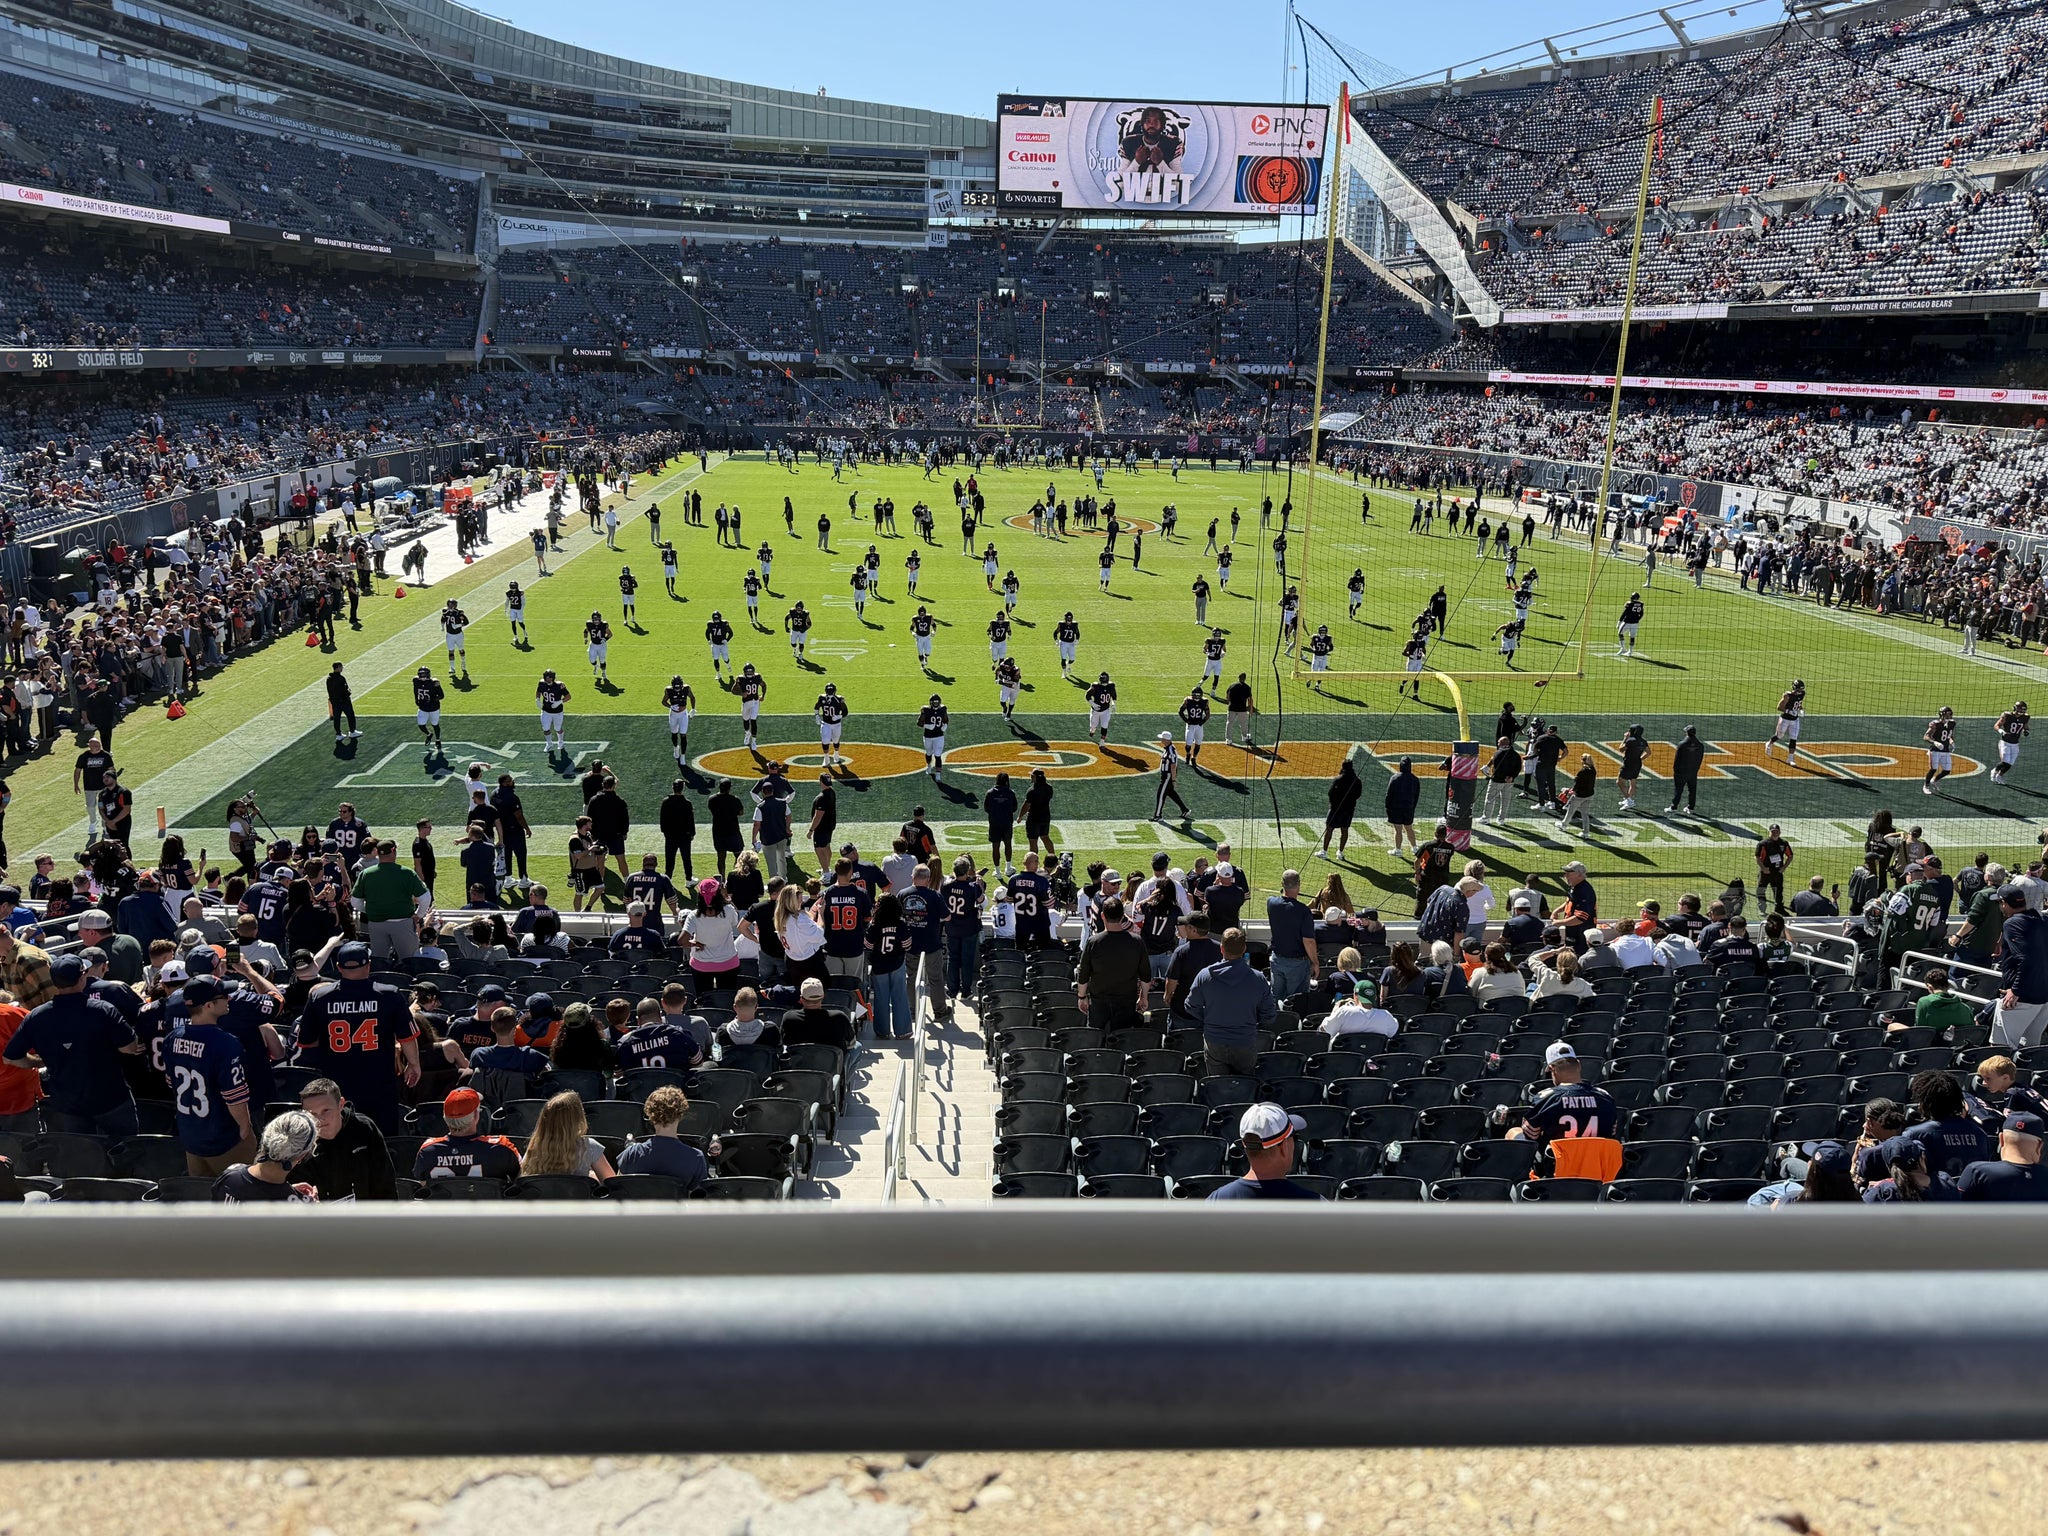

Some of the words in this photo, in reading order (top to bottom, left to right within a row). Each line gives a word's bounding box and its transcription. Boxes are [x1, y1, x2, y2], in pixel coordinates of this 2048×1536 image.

[1273, 118, 1313, 134] PNC
[1016, 133, 1049, 142] WARMUPS
[1008, 150, 1056, 163] Canon
[1104, 171, 1195, 205] SWIFT
[963, 193, 995, 205] 35:21
[1014, 194, 1056, 203] NOVARTIS
[18, 188, 44, 201] Canon
[62, 197, 83, 208] PROUD
[83, 200, 109, 213] PARTNER
[110, 205, 118, 214] OF
[119, 206, 130, 216] THE
[130, 208, 156, 220] CHICAGO
[156, 212, 173, 223] BEARS
[513, 222, 548, 232] LEXUS
[282, 231, 301, 241] Canon
[314, 237, 329, 246] PROUD
[329, 239, 347, 248] PARTNER
[353, 242, 361, 250] THE
[361, 244, 379, 252] CHICAGO
[379, 246, 391, 254] BEARS
[1790, 304, 1814, 312] Canon
[1831, 304, 1851, 312] PROUD
[1852, 303, 1878, 311] PARTNER
[1880, 302, 1888, 310] OF
[1888, 302, 1901, 310] THE
[1901, 300, 1931, 309] CHICAGO
[1931, 299, 1953, 308] BEARS
[1597, 311, 1615, 319] PARTNER
[1634, 310, 1654, 318] CHICAGO
[78, 352, 117, 366] SOLDIER
[120, 352, 144, 366] FIELD
[295, 352, 308, 363] PNC
[352, 352, 382, 363] ticketmaster
[579, 349, 612, 357] NOVARTIS
[651, 349, 702, 359] BEAR
[748, 351, 801, 362] DOWN
[32, 353, 53, 368] 35:21
[1109, 364, 1120, 374] 34
[1144, 362, 1197, 373] BEAR
[1238, 363, 1291, 374] DOWN
[2032, 393, 2048, 401] Work
[510, 596, 519, 605] 22
[446, 615, 456, 625] 79
[712, 627, 723, 636] 74
[918, 622, 929, 632] 62
[591, 629, 602, 639] 54
[995, 629, 1006, 638] 67
[1063, 629, 1074, 639] 73
[1211, 644, 1222, 653] 57
[1315, 642, 1327, 652] 53
[746, 683, 757, 695] 98
[543, 691, 555, 703] 96
[1100, 693, 1110, 704] 90
[823, 706, 834, 717] 50
[1190, 708, 1202, 718] 92
[930, 716, 942, 728] 93
[2009, 723, 2023, 734] 87
[1941, 730, 1953, 741] 84
[335, 830, 357, 848] 99
[165, 873, 178, 889] 18
[1016, 879, 1035, 888] HESTER
[632, 886, 656, 911] 54
[830, 896, 856, 904] WILLIAMS
[1014, 892, 1037, 916] 23
[257, 897, 278, 921] 15
[949, 895, 965, 916] 92
[830, 905, 858, 931] 18
[1151, 915, 1168, 936] 17
[881, 935, 896, 954] 15
[327, 1000, 379, 1014] LOVELAND
[328, 1018, 379, 1052] 84
[463, 1033, 492, 1046] HESTER
[172, 1036, 205, 1058] HESTER
[632, 1036, 670, 1053] WILLIAMS
[174, 1065, 210, 1118] 23
[1562, 1096, 1598, 1109] PAYTON
[1943, 1134, 1977, 1146] HESTER
[437, 1154, 475, 1166] PAYTON
